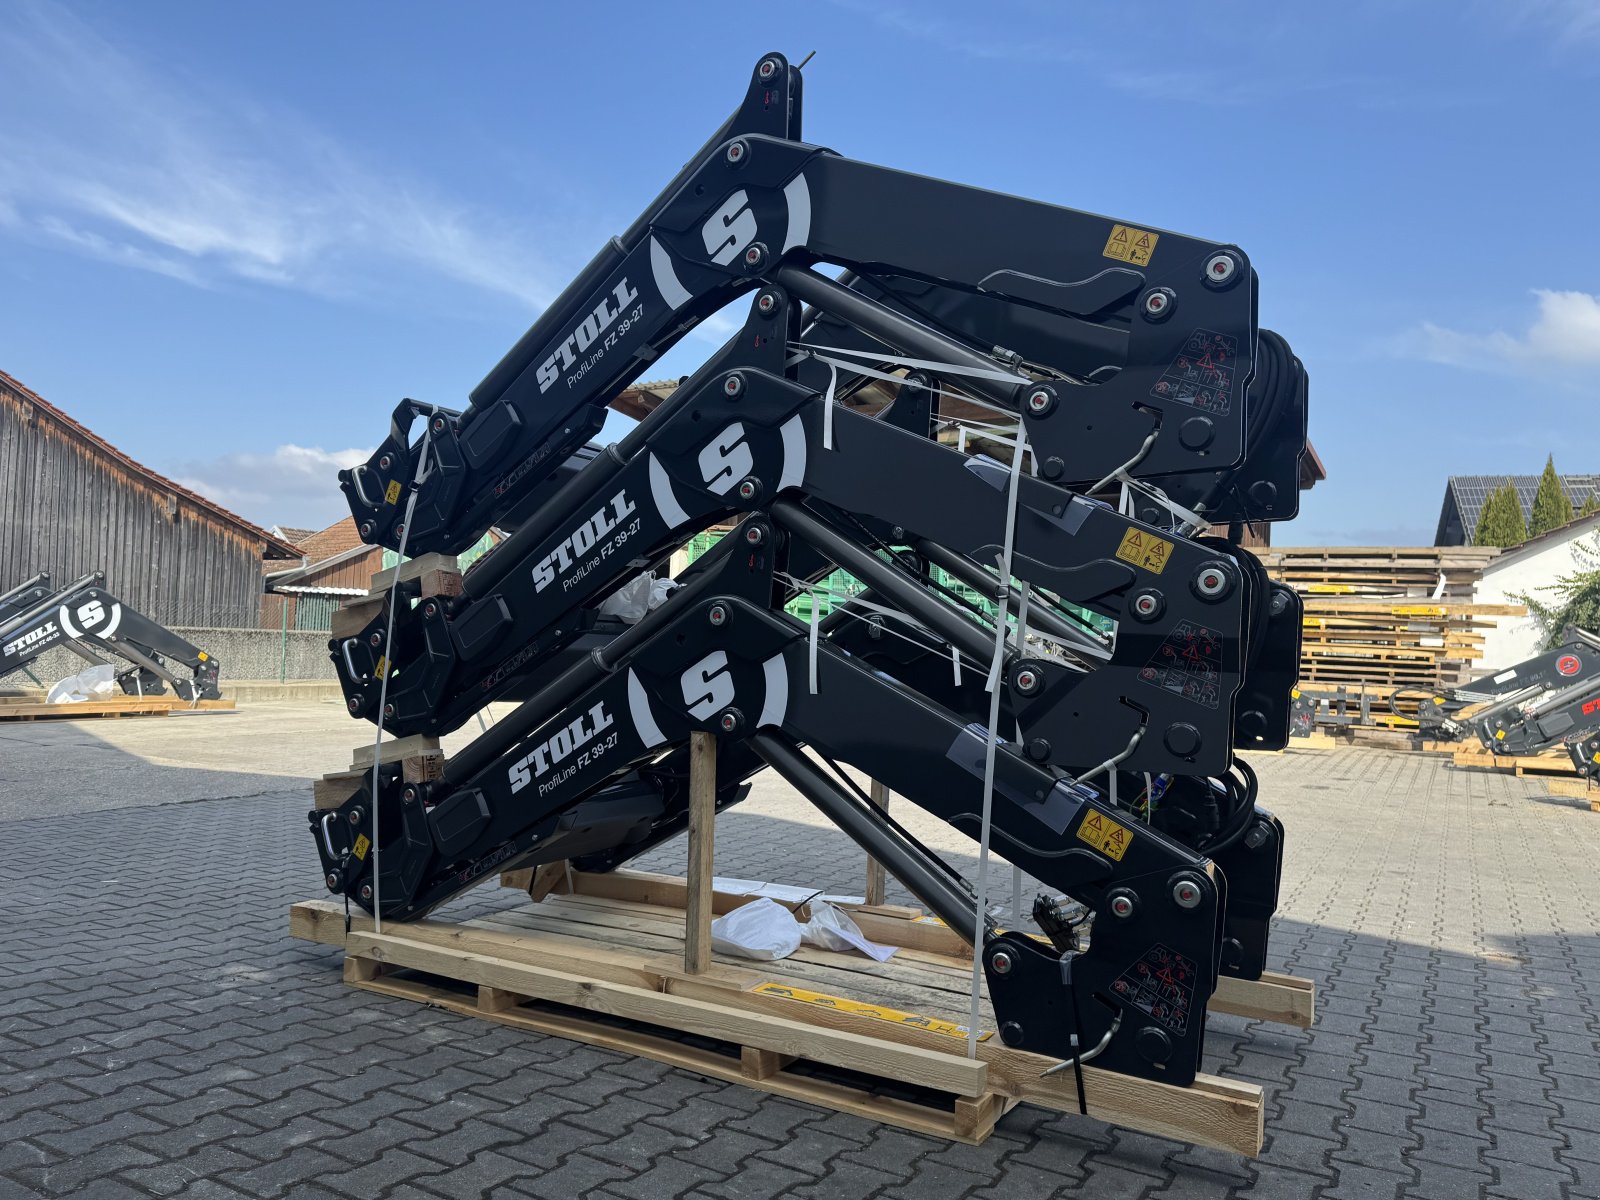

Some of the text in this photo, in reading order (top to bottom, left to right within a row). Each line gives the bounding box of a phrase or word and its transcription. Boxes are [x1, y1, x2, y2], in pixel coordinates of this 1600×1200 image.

[702, 189, 757, 266] S
[536, 277, 639, 395] STOLL
[567, 303, 644, 389] ProfiLine FZ 39-27
[698, 422, 754, 496] S
[532, 489, 637, 594] STOLL
[563, 518, 641, 592] ProfiLine FZ 39-27
[3, 621, 57, 656] STOLL
[77, 600, 105, 629] S
[681, 651, 735, 721] S
[508, 701, 614, 795] STOLL
[539, 732, 618, 797] ProfiLine FZ 39-27
